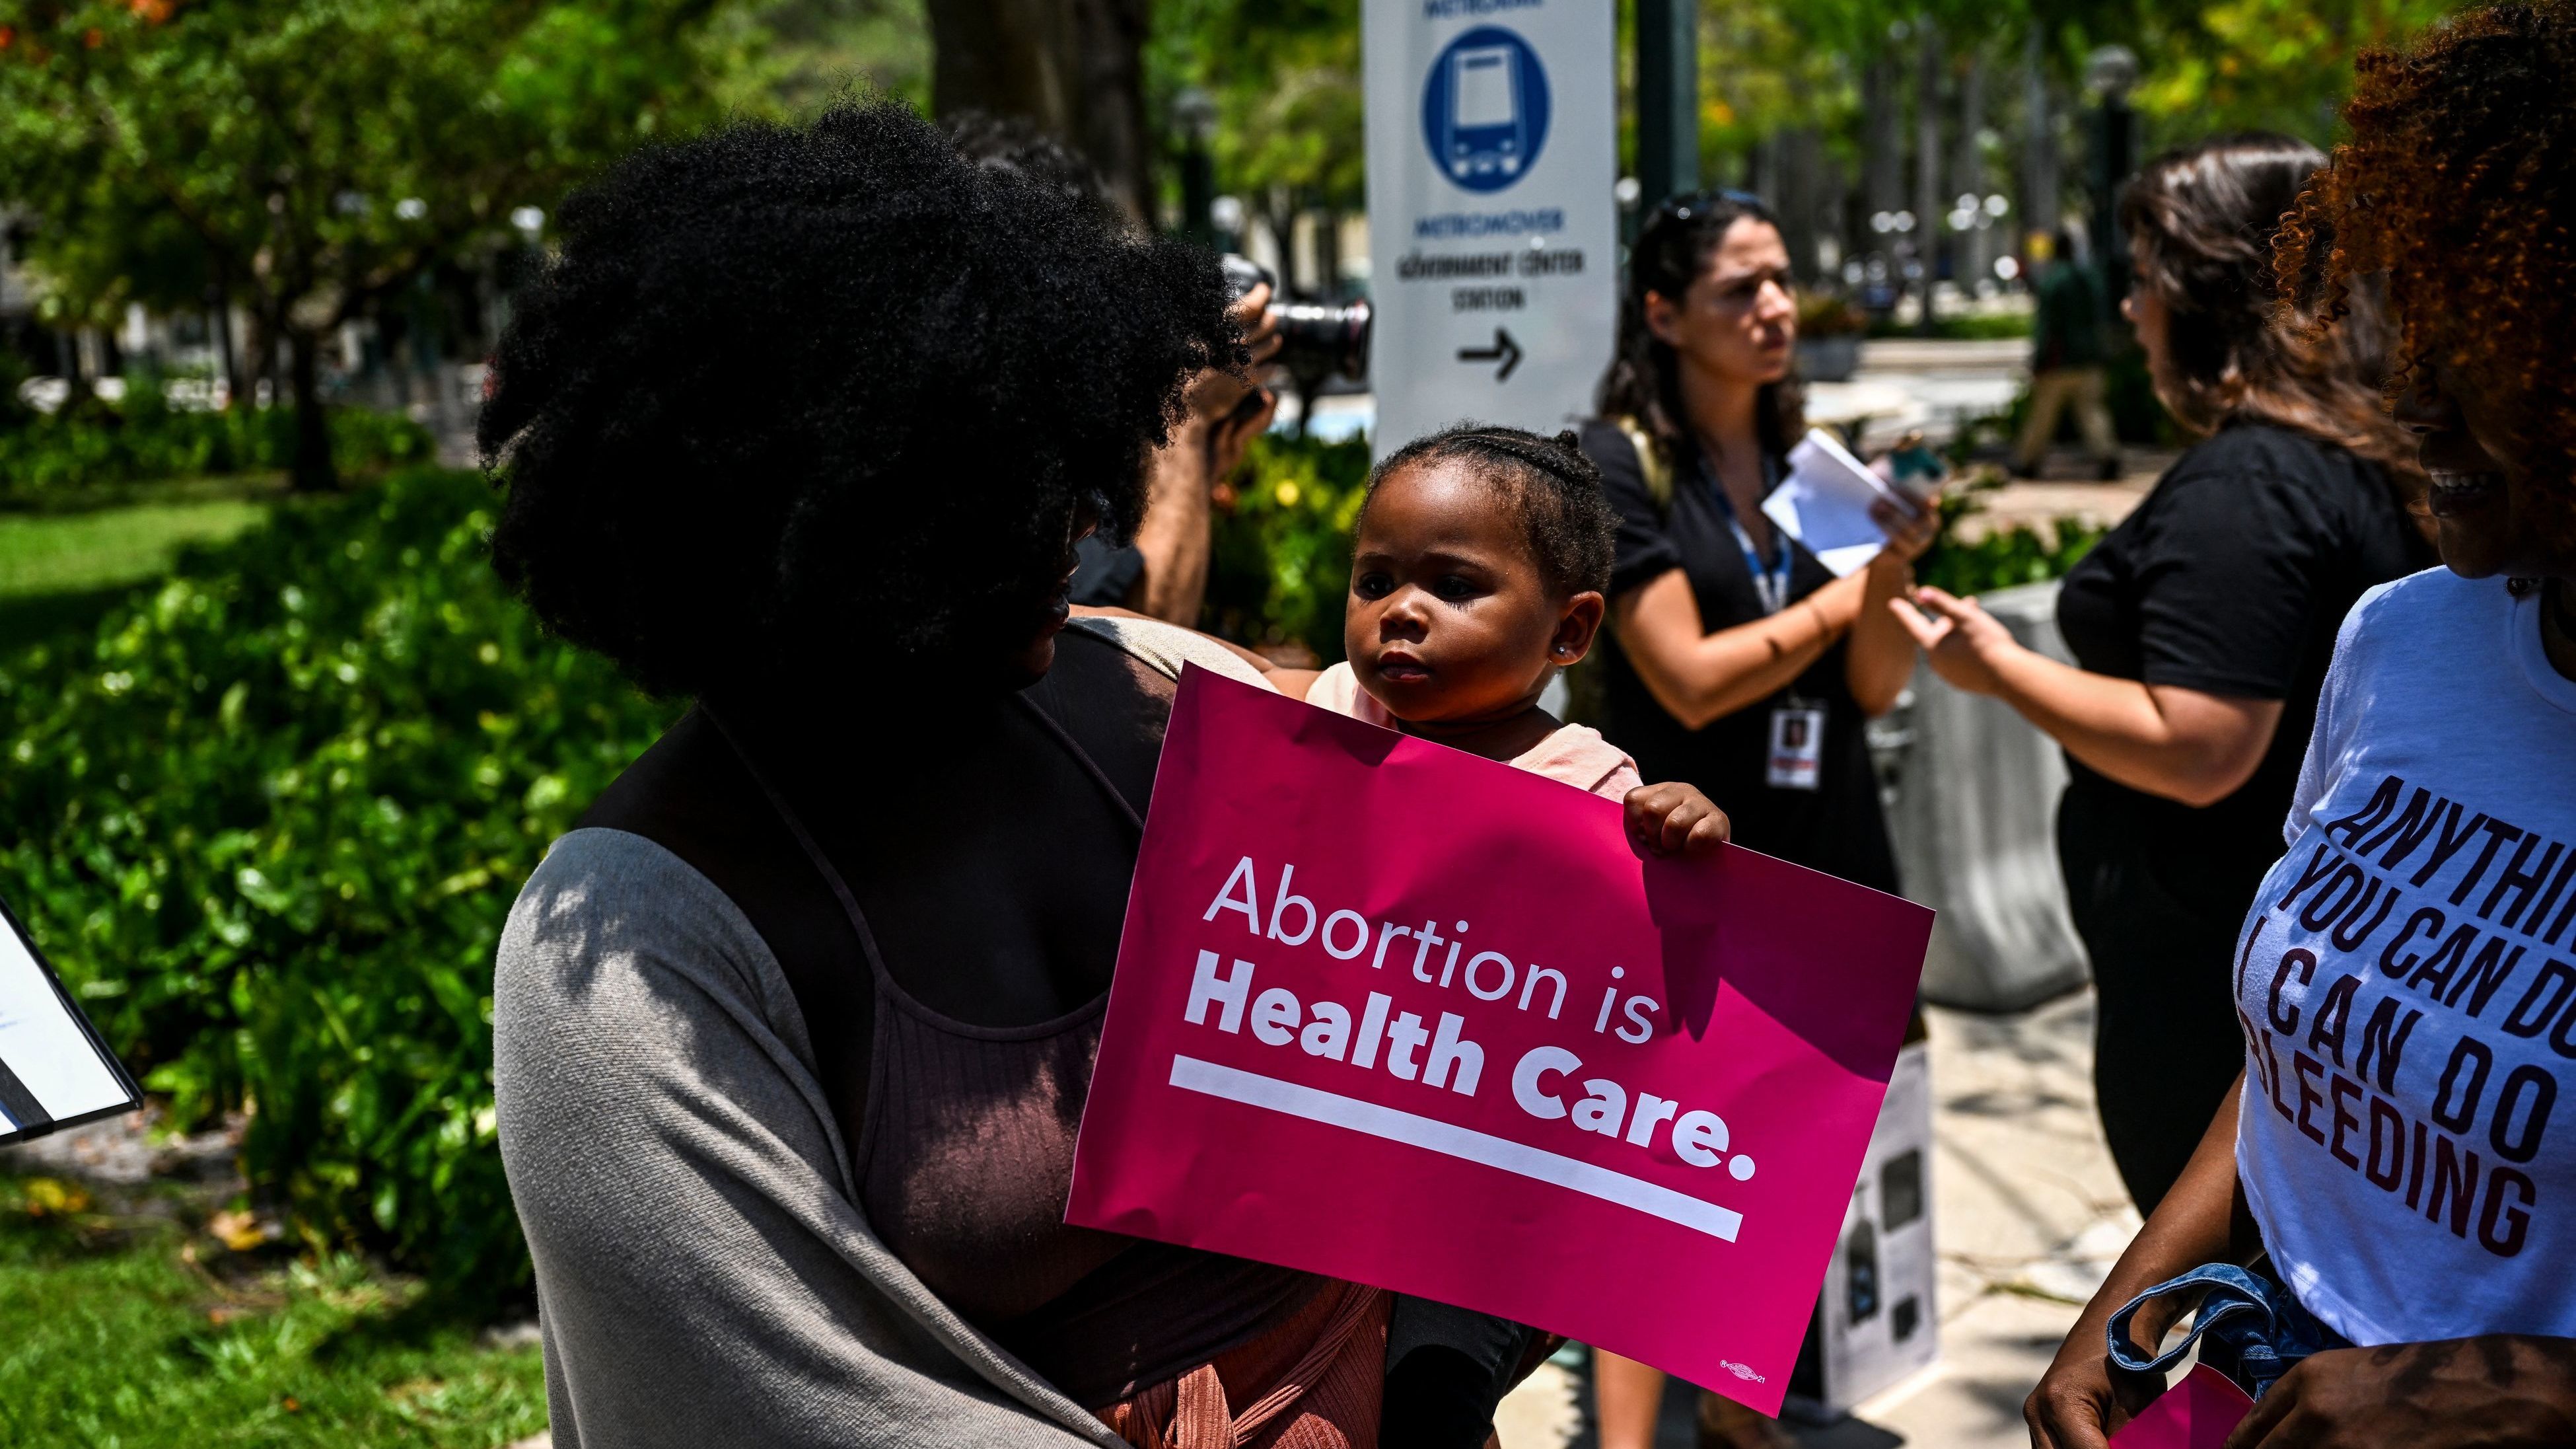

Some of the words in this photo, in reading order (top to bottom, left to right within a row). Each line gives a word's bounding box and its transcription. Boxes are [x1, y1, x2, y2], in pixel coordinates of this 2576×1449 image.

[1203, 856, 1567, 1020] Abortion
[1594, 966, 1660, 1043] is
[2237, 916, 2267, 1001] I
[2268, 948, 2421, 1097] CAN
[2431, 1036, 2558, 1164] DO
[2279, 844, 2401, 952] YOU
[2380, 908, 2526, 1018] CAN
[1184, 949, 1484, 1096] Health
[1512, 1046, 1755, 1181] Care.
[2238, 1006, 2538, 1258] BLEEDING
